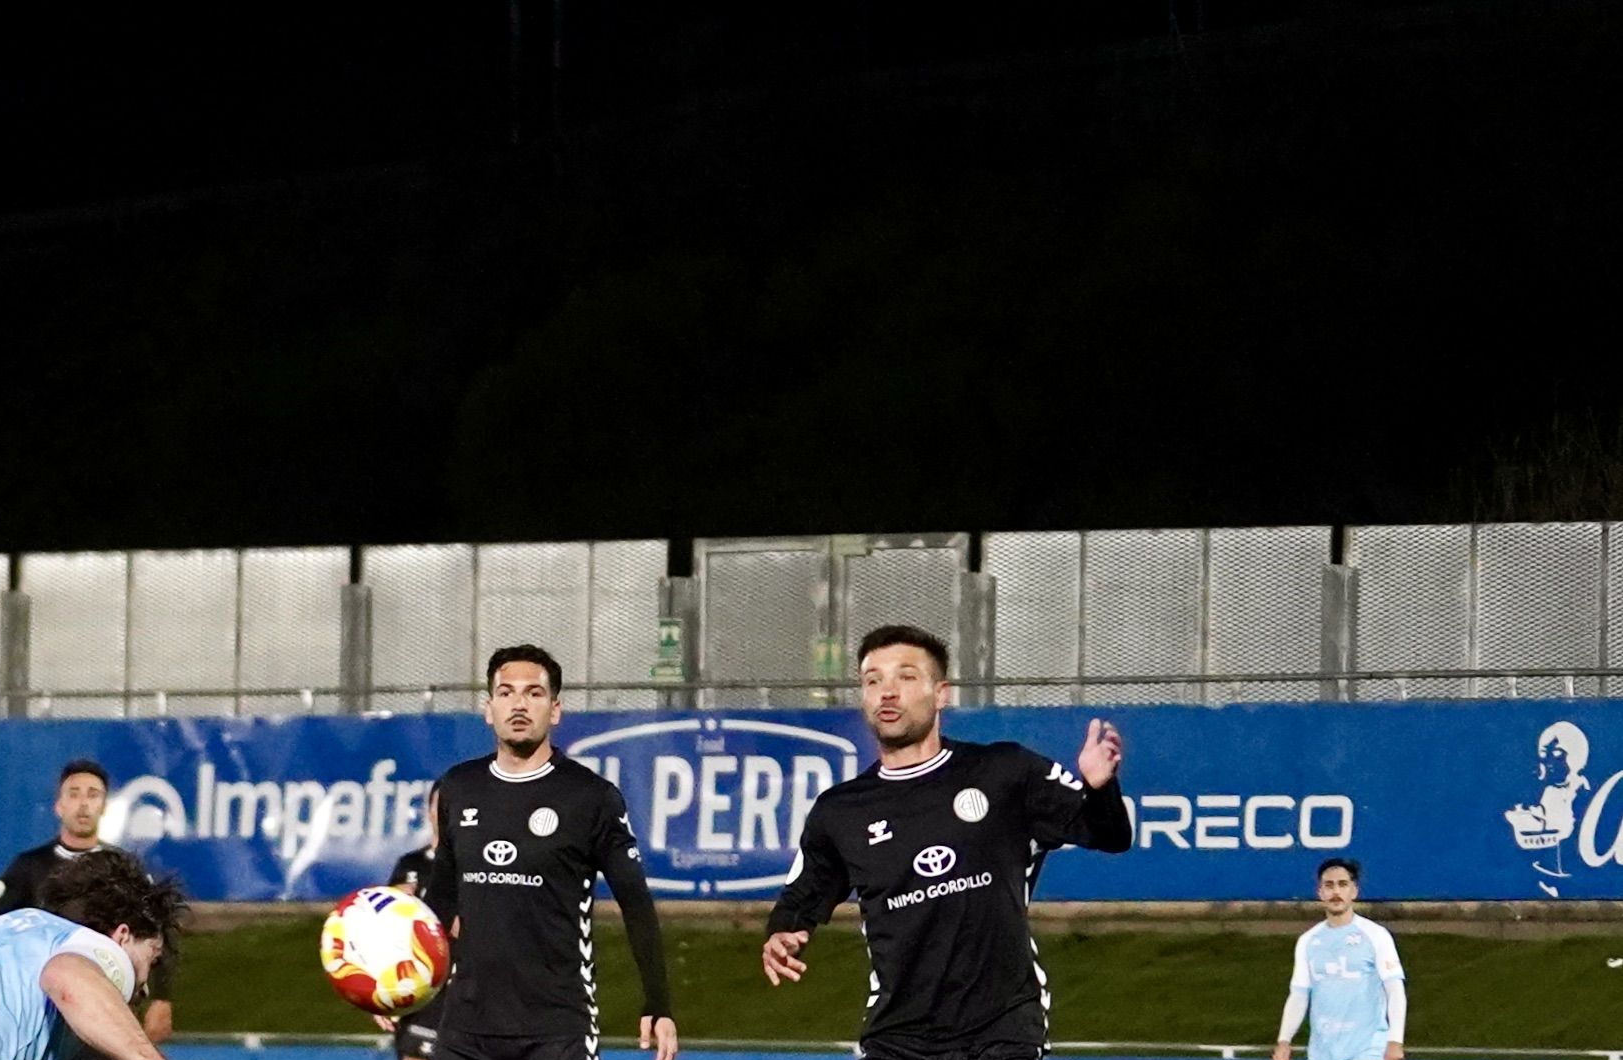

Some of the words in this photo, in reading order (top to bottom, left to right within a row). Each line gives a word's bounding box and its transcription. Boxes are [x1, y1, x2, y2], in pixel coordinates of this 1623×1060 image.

[197, 758, 435, 859] Impafr
[650, 755, 858, 850] PERR
[1122, 795, 1354, 848] RECO
[488, 872, 544, 887] GORDILLO
[887, 889, 925, 910] NIMO
[926, 872, 993, 899] GORDILLO
